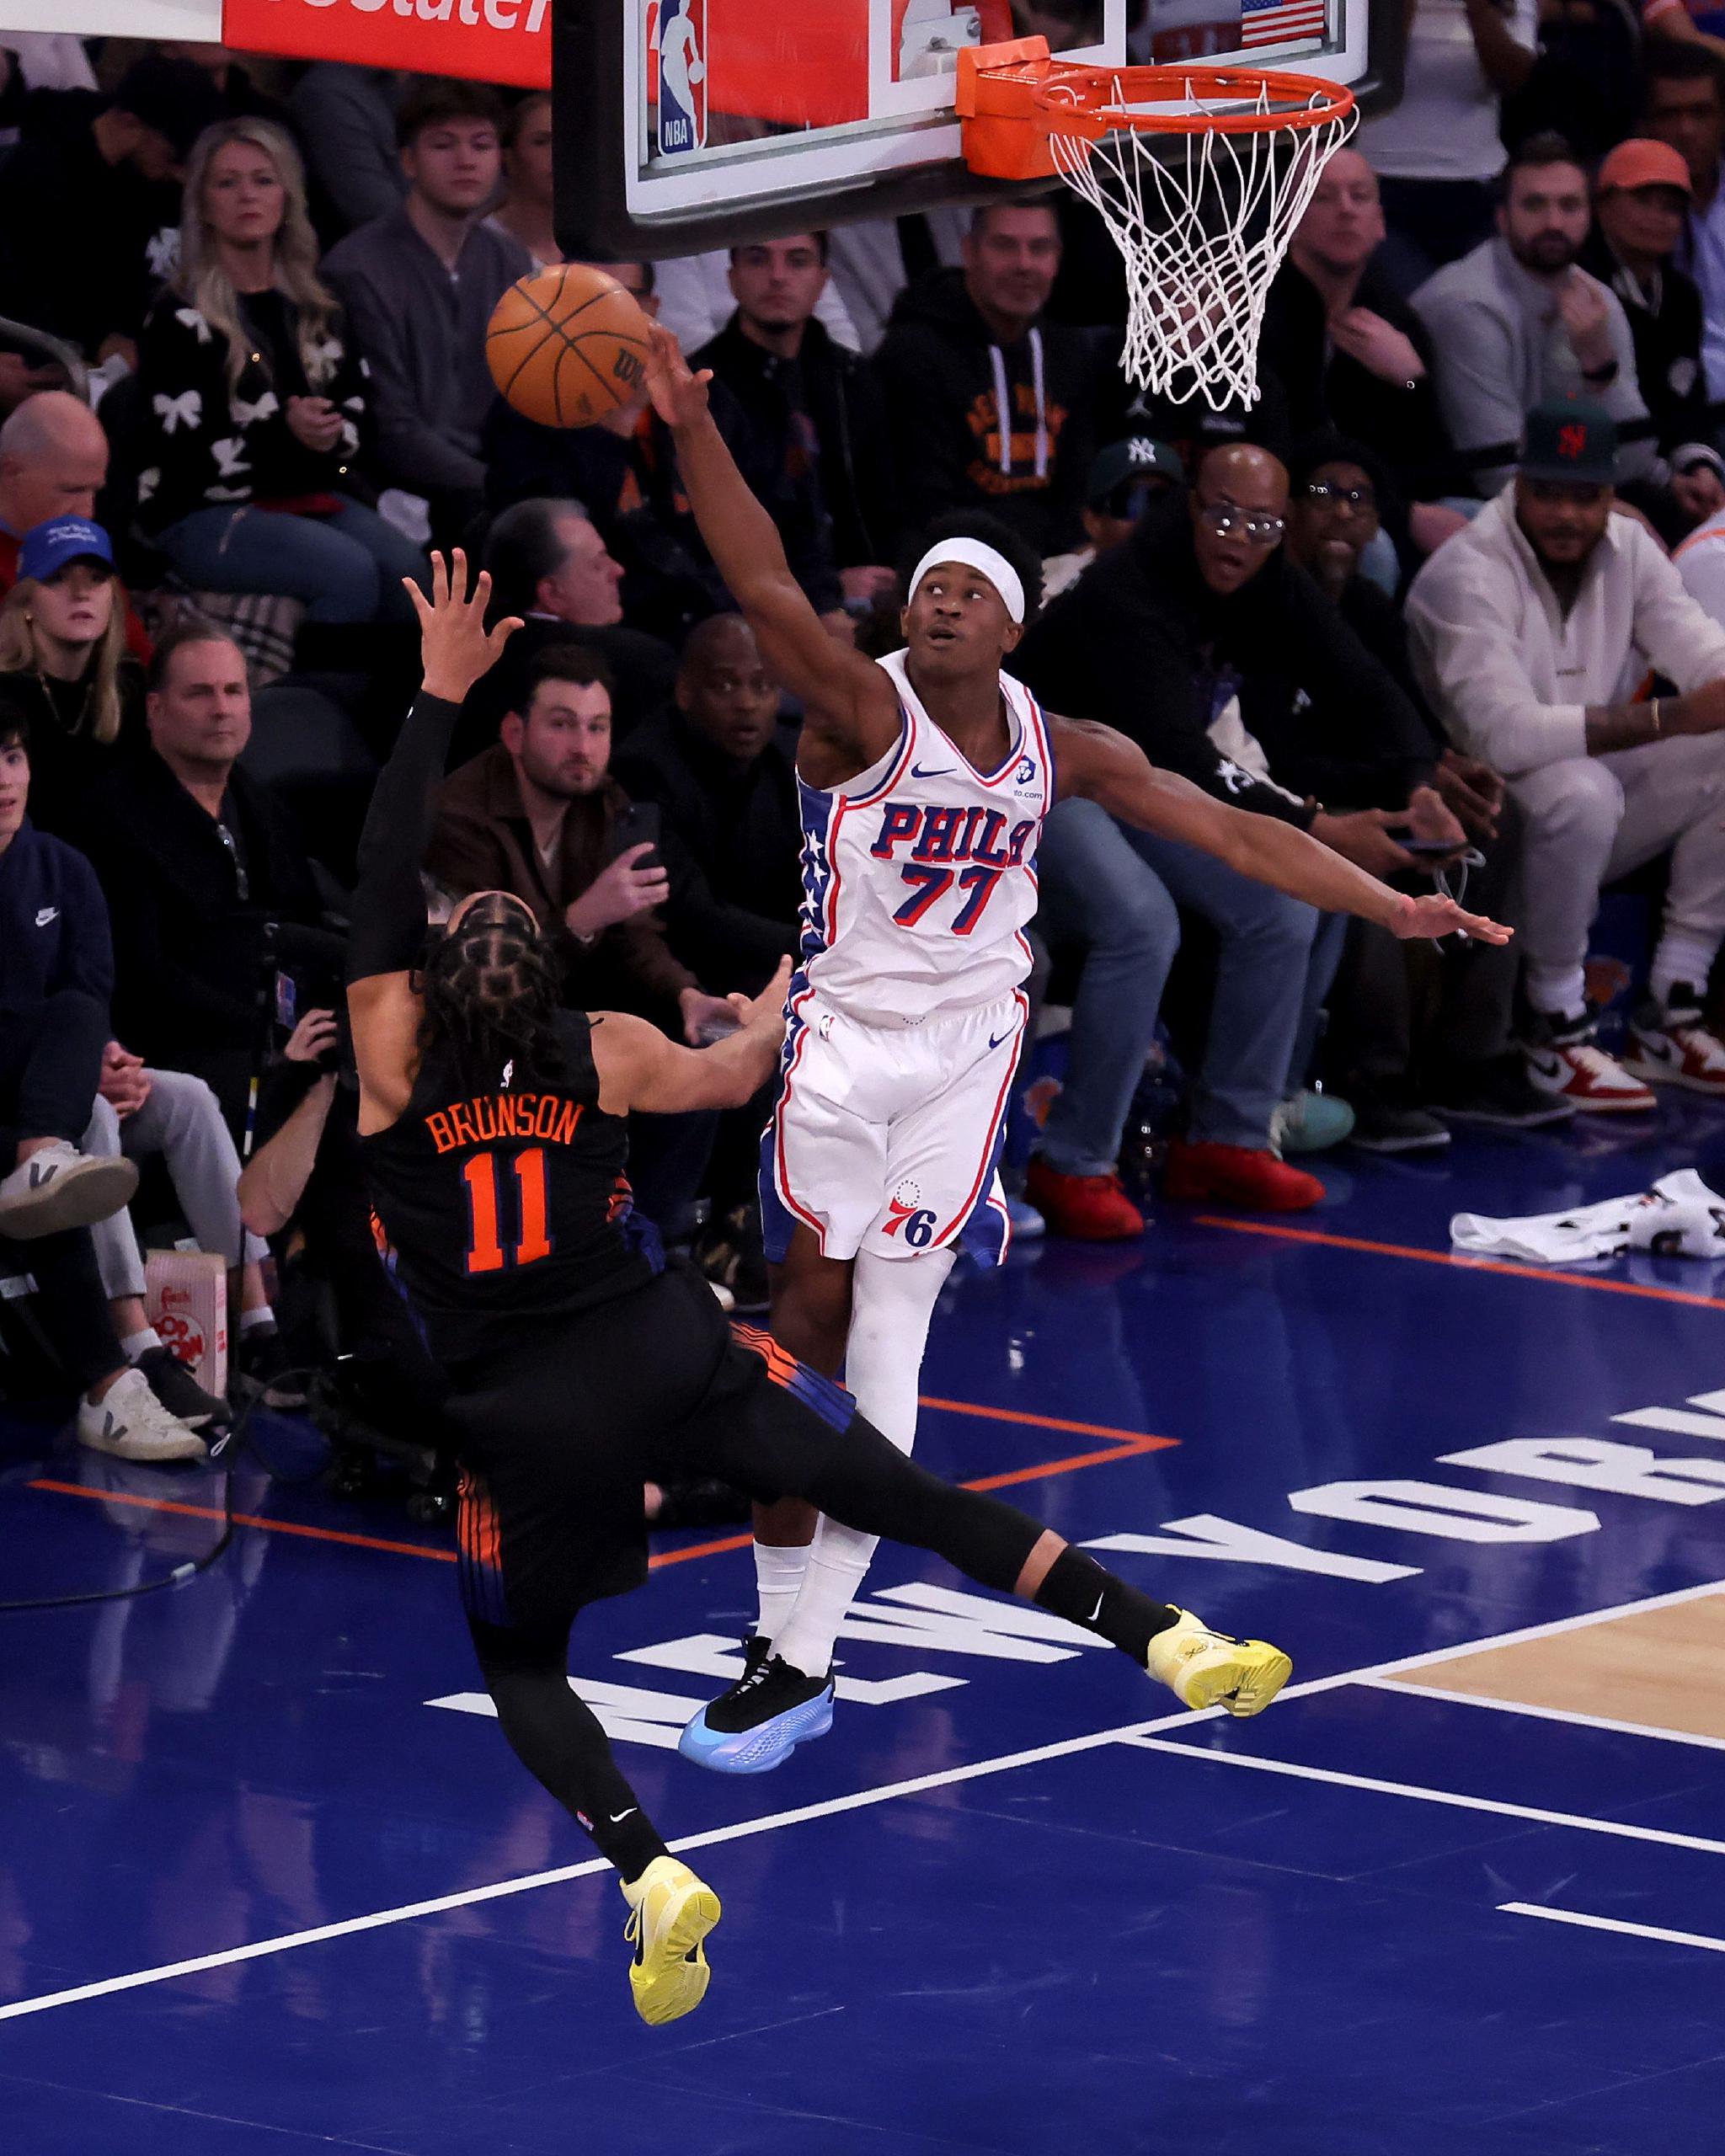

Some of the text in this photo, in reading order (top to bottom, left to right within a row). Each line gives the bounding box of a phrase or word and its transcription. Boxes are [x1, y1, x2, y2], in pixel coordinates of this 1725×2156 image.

[665, 118, 688, 147] NBA
[870, 803, 1036, 868] PHILA
[892, 863, 1004, 936] 77
[425, 1092, 585, 1155] BRUNSON
[462, 1146, 552, 1274] 11
[881, 1195, 937, 1247] 76
